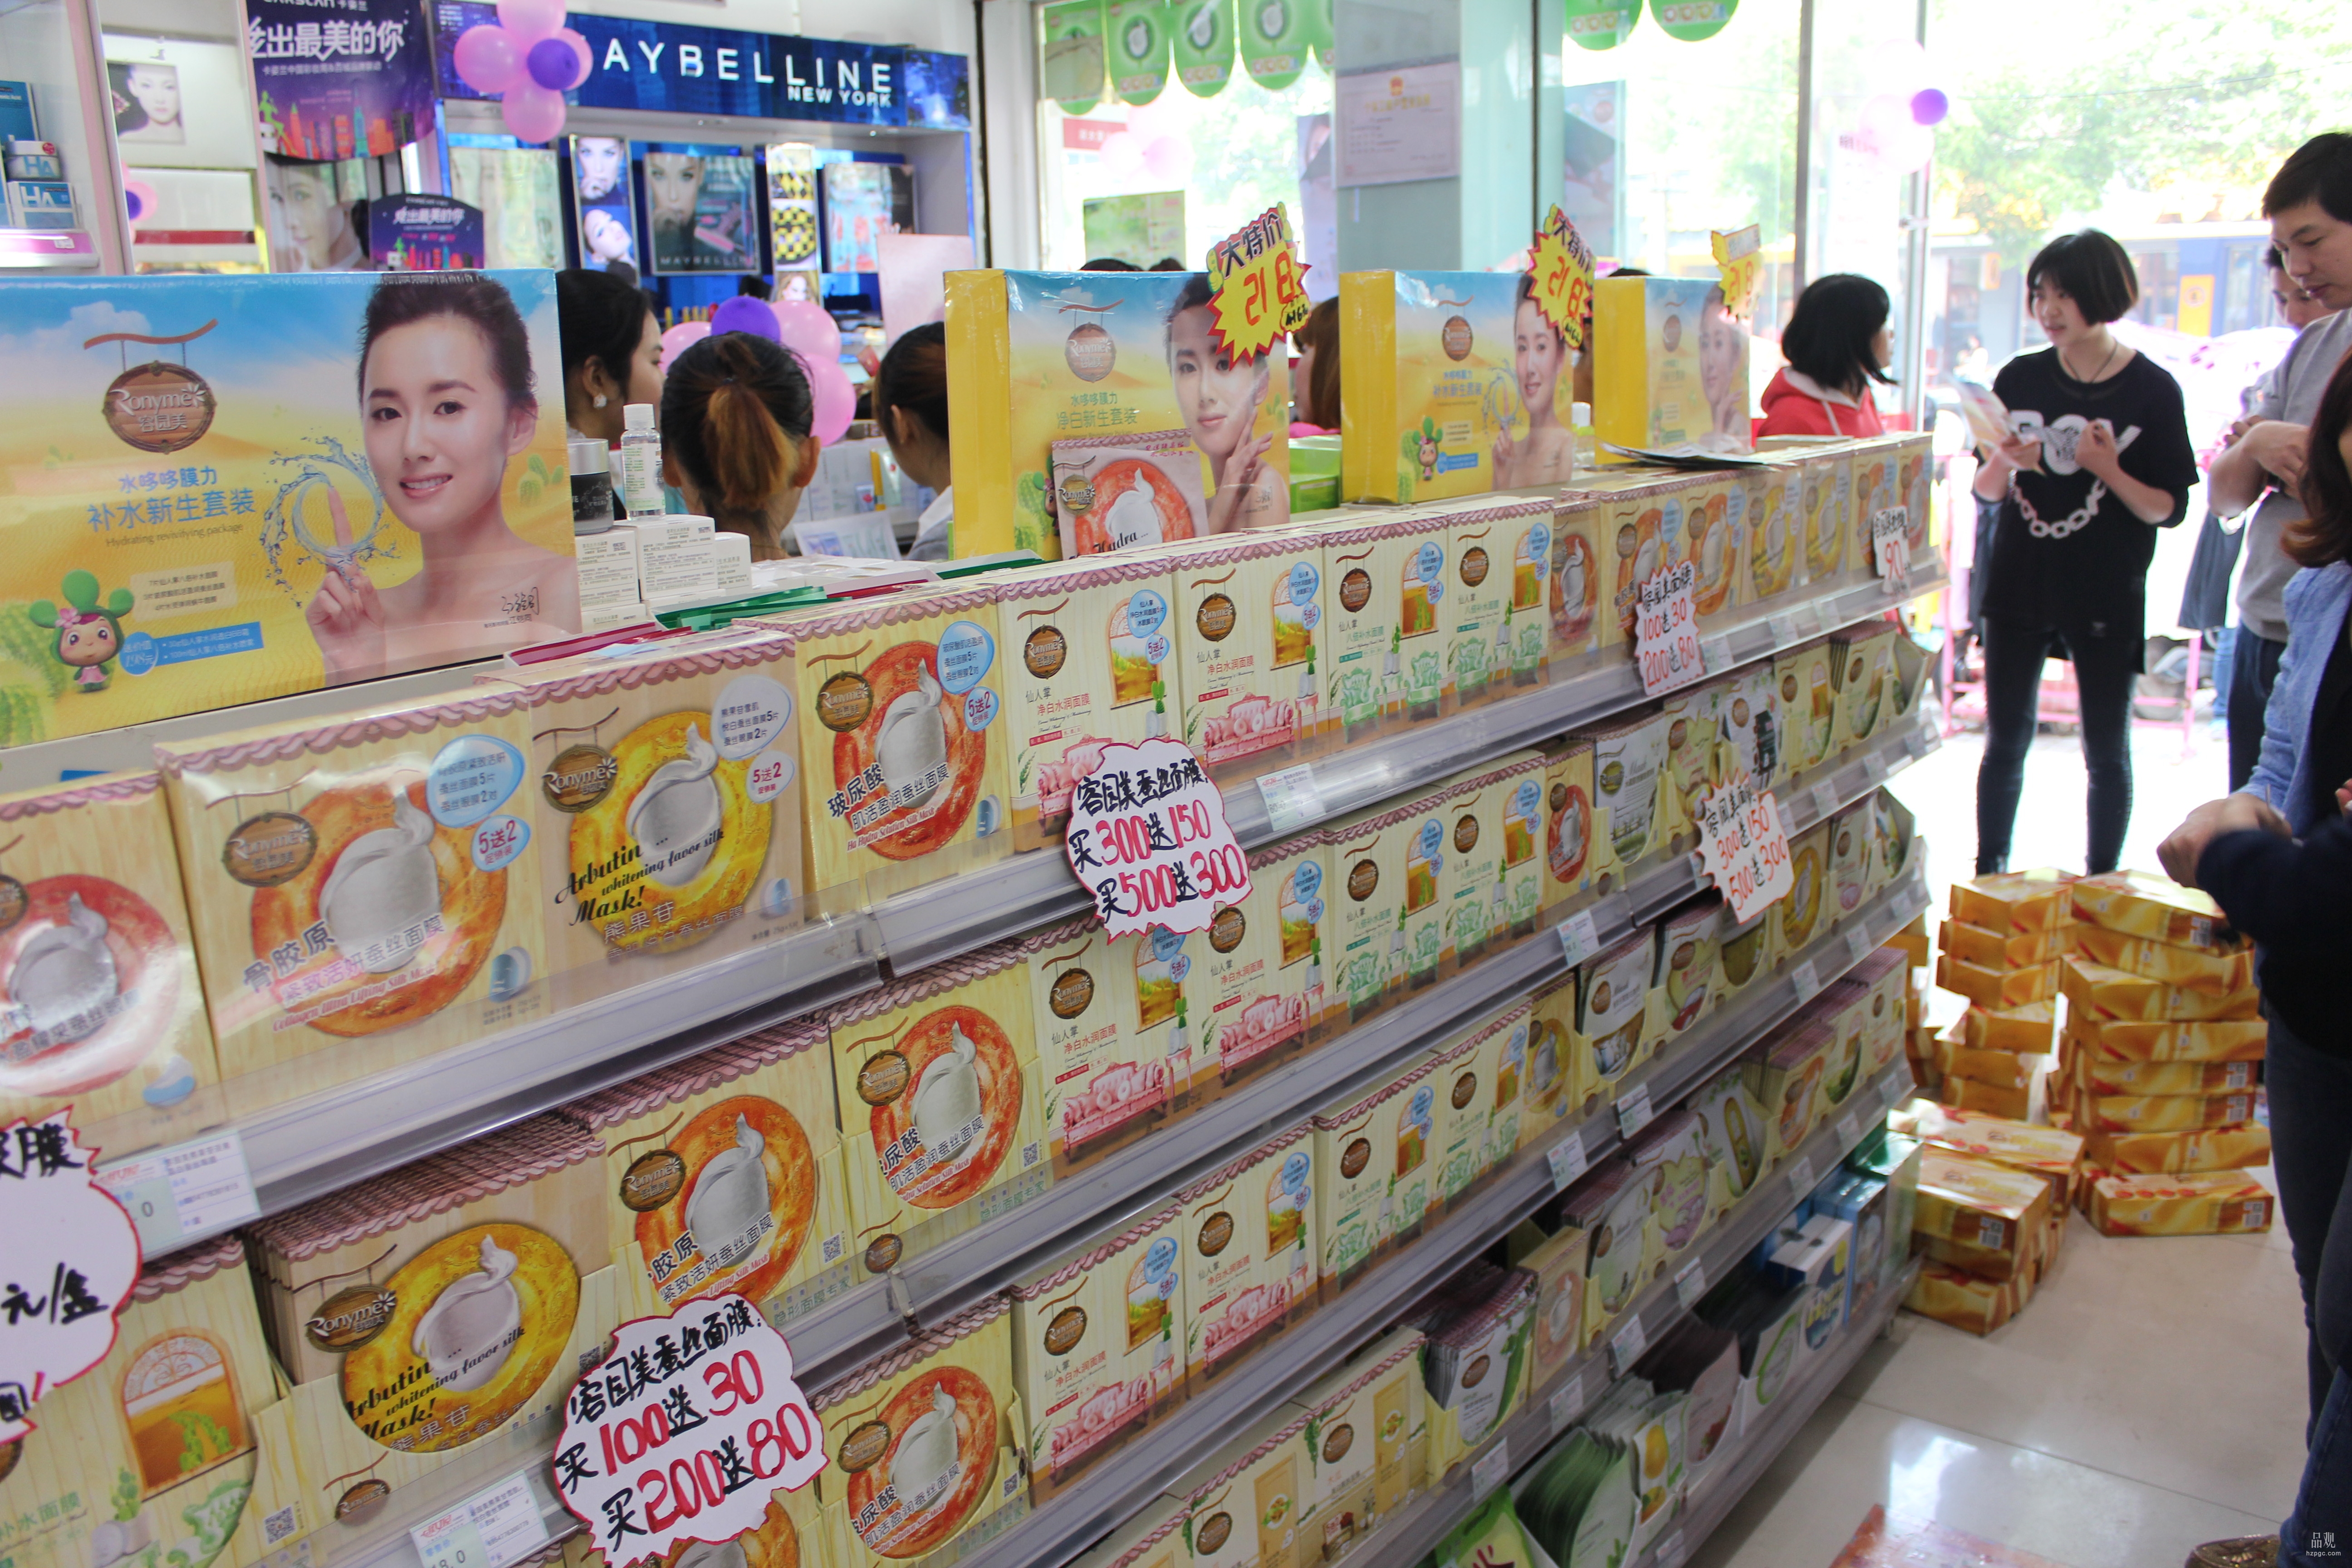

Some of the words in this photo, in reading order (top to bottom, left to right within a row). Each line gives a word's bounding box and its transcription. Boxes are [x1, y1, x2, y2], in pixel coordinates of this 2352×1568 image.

[602, 37, 892, 92] AYBELLINE
[788, 85, 832, 105] NEW
[839, 87, 892, 108] YORK
[20, 186, 57, 208] HA
[1220, 211, 1284, 280] 大特价
[1068, 339, 1111, 356] Ronyme
[108, 383, 206, 415] Ronyme
[1071, 392, 1118, 407] 水哆哆膜力
[139, 413, 188, 433] 容园美
[1056, 407, 1137, 430] 净白新生套装
[118, 466, 218, 494] 水哆哆膜力
[1058, 485, 1096, 502] Ronyme
[87, 488, 256, 533] 补水新生套装
[105, 533, 155, 549] Hydrating
[207, 522, 244, 538] package
[1458, 593, 1476, 605] 仙人掌
[1339, 619, 1357, 632] 仙人掌
[1644, 598, 1687, 643] 100送30
[1026, 637, 1063, 659] Ronyme
[1148, 637, 1164, 654] 5送2
[1196, 647, 1221, 664] 仙人掌
[1207, 655, 1255, 676] 净白水润面膜
[1644, 636, 1695, 688] 200送80
[820, 682, 869, 710] Ronyme
[968, 691, 991, 715] 5送2
[1025, 686, 1052, 703] 仙人掌
[1037, 692, 1090, 716] 净白水润面膜
[543, 757, 617, 794] Ronyme
[752, 761, 782, 784] 5送2
[827, 762, 885, 818] 玻尿酸
[852, 762, 951, 832] 肌活盈润蚕丝面膜
[478, 820, 517, 854] 5送2
[847, 840, 857, 852] Ha
[858, 831, 878, 848] Hydra
[879, 820, 905, 841] Solution
[905, 815, 919, 828] Silk
[920, 806, 936, 822] Mask
[1069, 799, 1212, 873] 买300送150
[1717, 805, 1770, 870] 300送150
[554, 843, 643, 904] Arbutin
[601, 859, 665, 896] whitening
[668, 843, 702, 867] favor
[703, 828, 725, 851] silk
[1729, 834, 1788, 911] 500送300
[1097, 844, 1247, 924] 买500送300
[569, 885, 646, 927] Mask!
[1346, 907, 1366, 924] 仙人掌
[603, 900, 675, 944] 熊果苷
[242, 920, 335, 994] 骨胶原
[279, 914, 446, 1007] 紧致活妍蚕丝面膜
[1171, 956, 1186, 972] 5送2
[1210, 958, 1233, 976] 仙人掌
[1220, 958, 1264, 987] 净白水润面膜
[387, 974, 407, 994] Silk
[1053, 975, 1091, 1000] Ronyme
[1052, 1025, 1078, 1045] 仙人掌
[1064, 1023, 1117, 1054] 净白水润面膜
[861, 1058, 906, 1086] Ronyme
[874, 1078, 898, 1096] 容园美
[890, 1116, 985, 1193] 肌活盈润蚕丝面膜
[623, 1158, 681, 1191] Ronyme
[916, 1175, 941, 1196] Solution
[942, 1169, 953, 1183] Silk
[954, 1158, 970, 1176] Mask
[640, 1180, 671, 1202] 容园美
[648, 1231, 699, 1281] 胶原
[660, 1213, 774, 1303] 紧致活妍蚕丝面膜
[1198, 1261, 1220, 1280] 仙人掌
[1207, 1254, 1250, 1287] 净白水润面膜
[710, 1273, 735, 1296] Lifting
[735, 1266, 750, 1282] Silk
[750, 1253, 769, 1272] Mask
[306, 1291, 396, 1338] Ronyme
[387, 1370, 458, 1416] whitening
[462, 1345, 500, 1374] favor
[502, 1326, 526, 1350] silk
[1044, 1359, 1071, 1382] 仙人掌
[1054, 1350, 1107, 1388] 净白水润面膜
[554, 1349, 764, 1494] 买100送30
[601, 1402, 812, 1552] 买200送80
[865, 1461, 961, 1547] 肌活盈润蚕丝面膜
[916, 1514, 929, 1530] Silk
[930, 1503, 946, 1521] Mask
